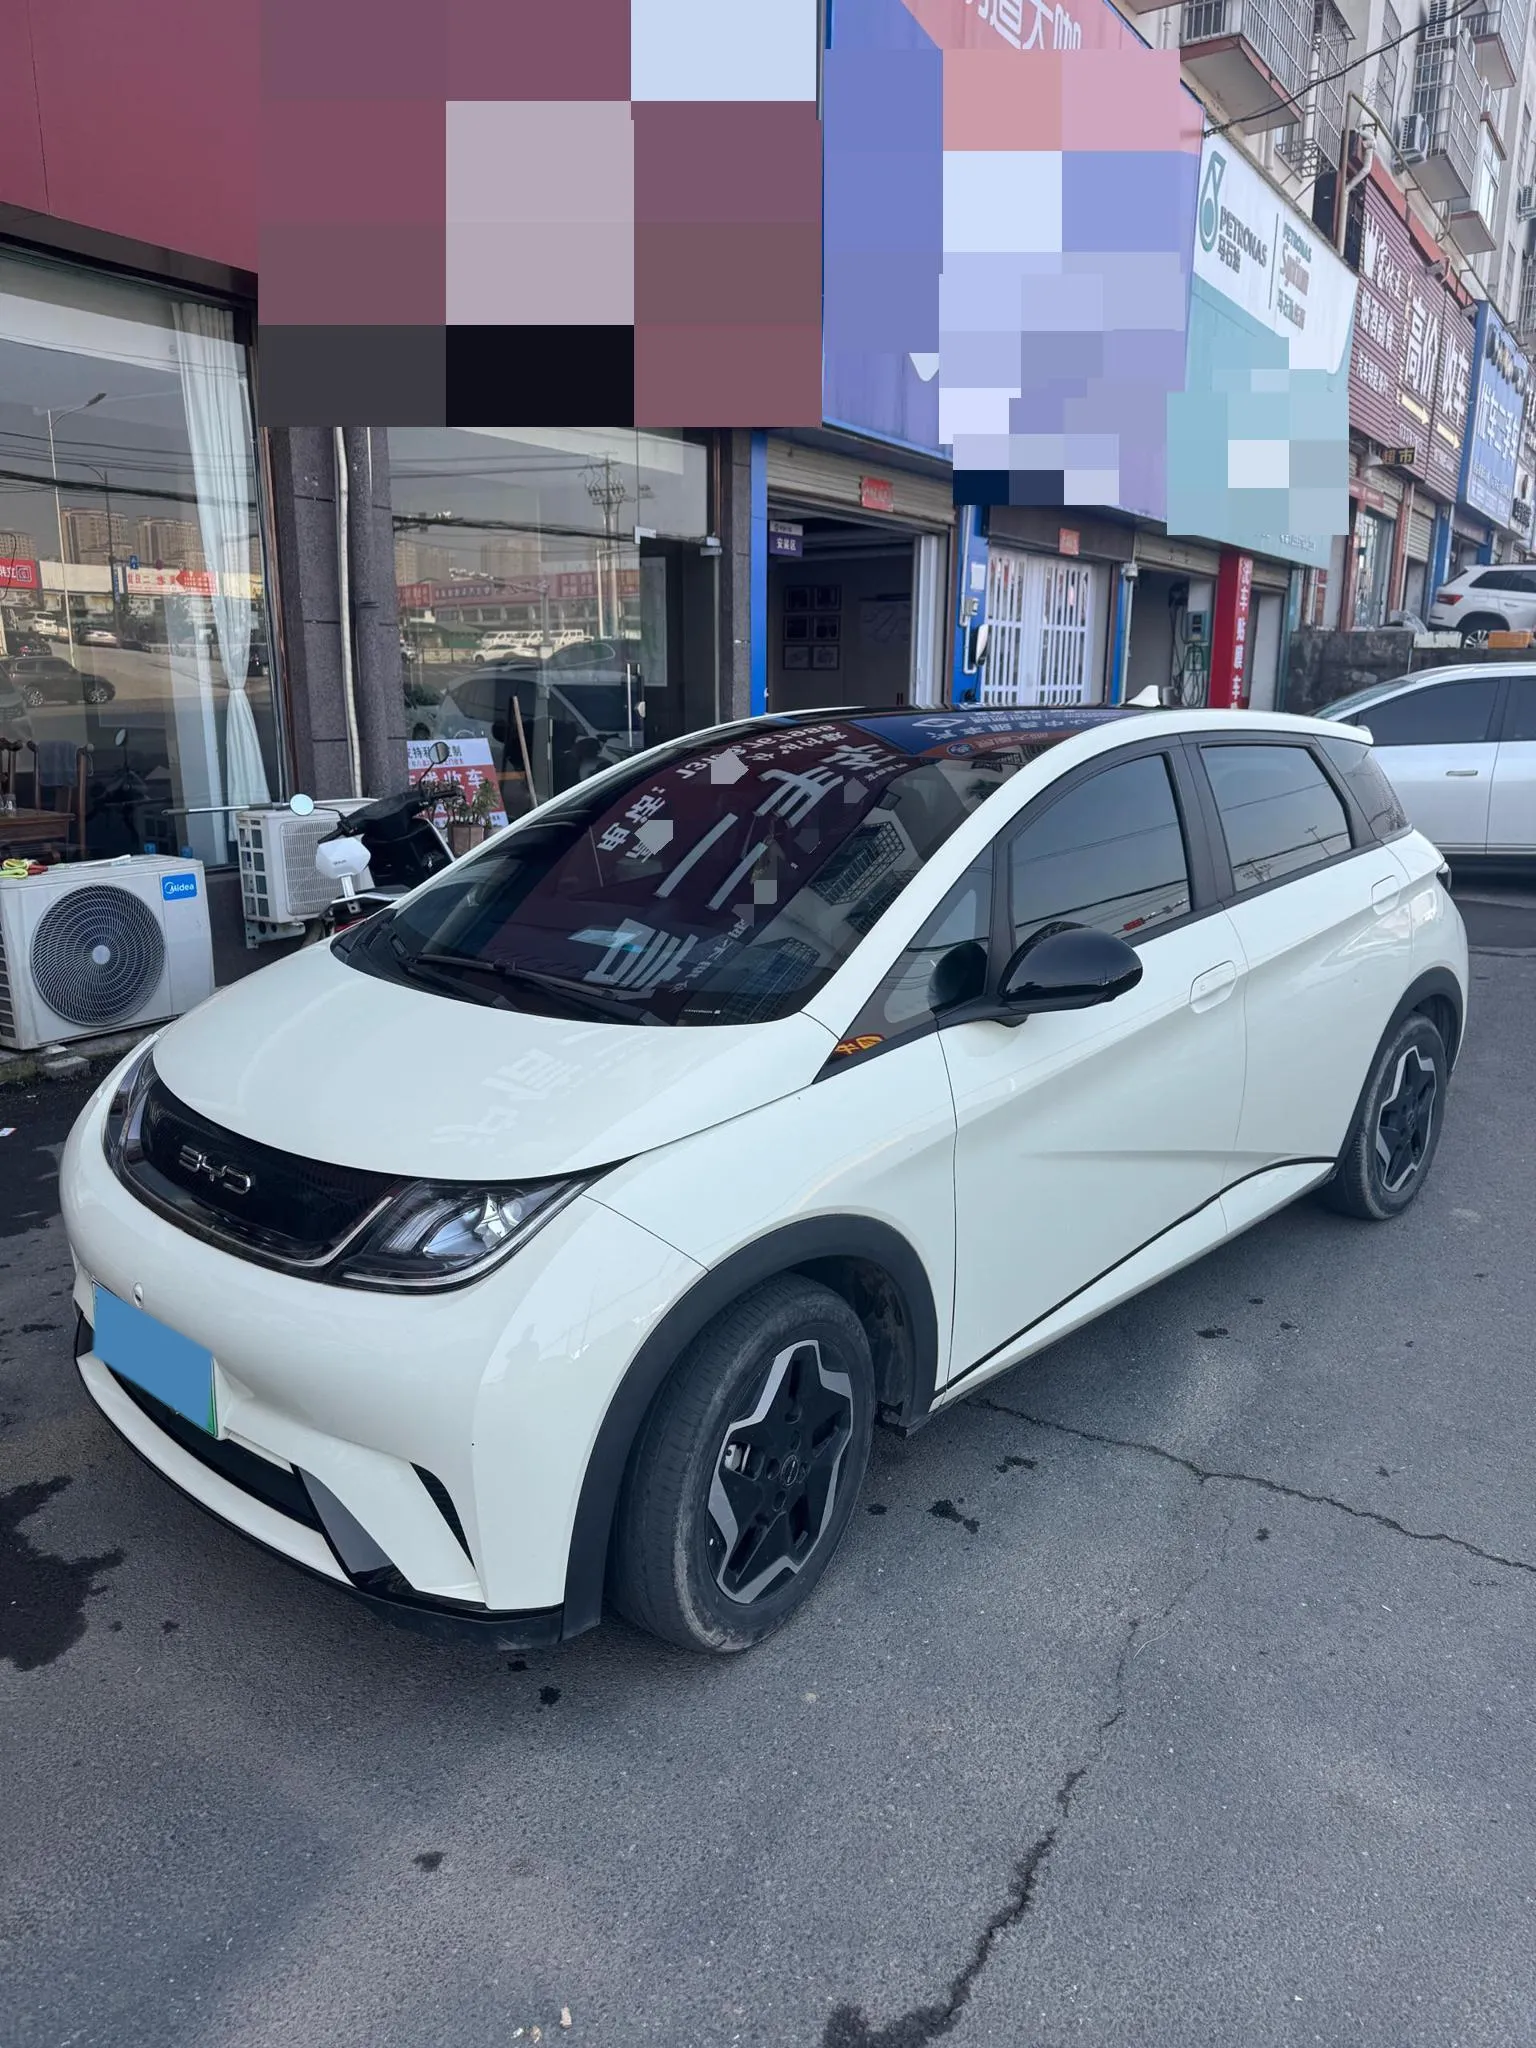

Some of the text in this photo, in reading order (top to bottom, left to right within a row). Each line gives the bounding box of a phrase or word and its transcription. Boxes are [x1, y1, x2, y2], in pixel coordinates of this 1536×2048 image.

[1219, 206, 1267, 268] PETRONAS
[164, 882, 195, 895] Midea
[179, 1144, 251, 1195] BYD
